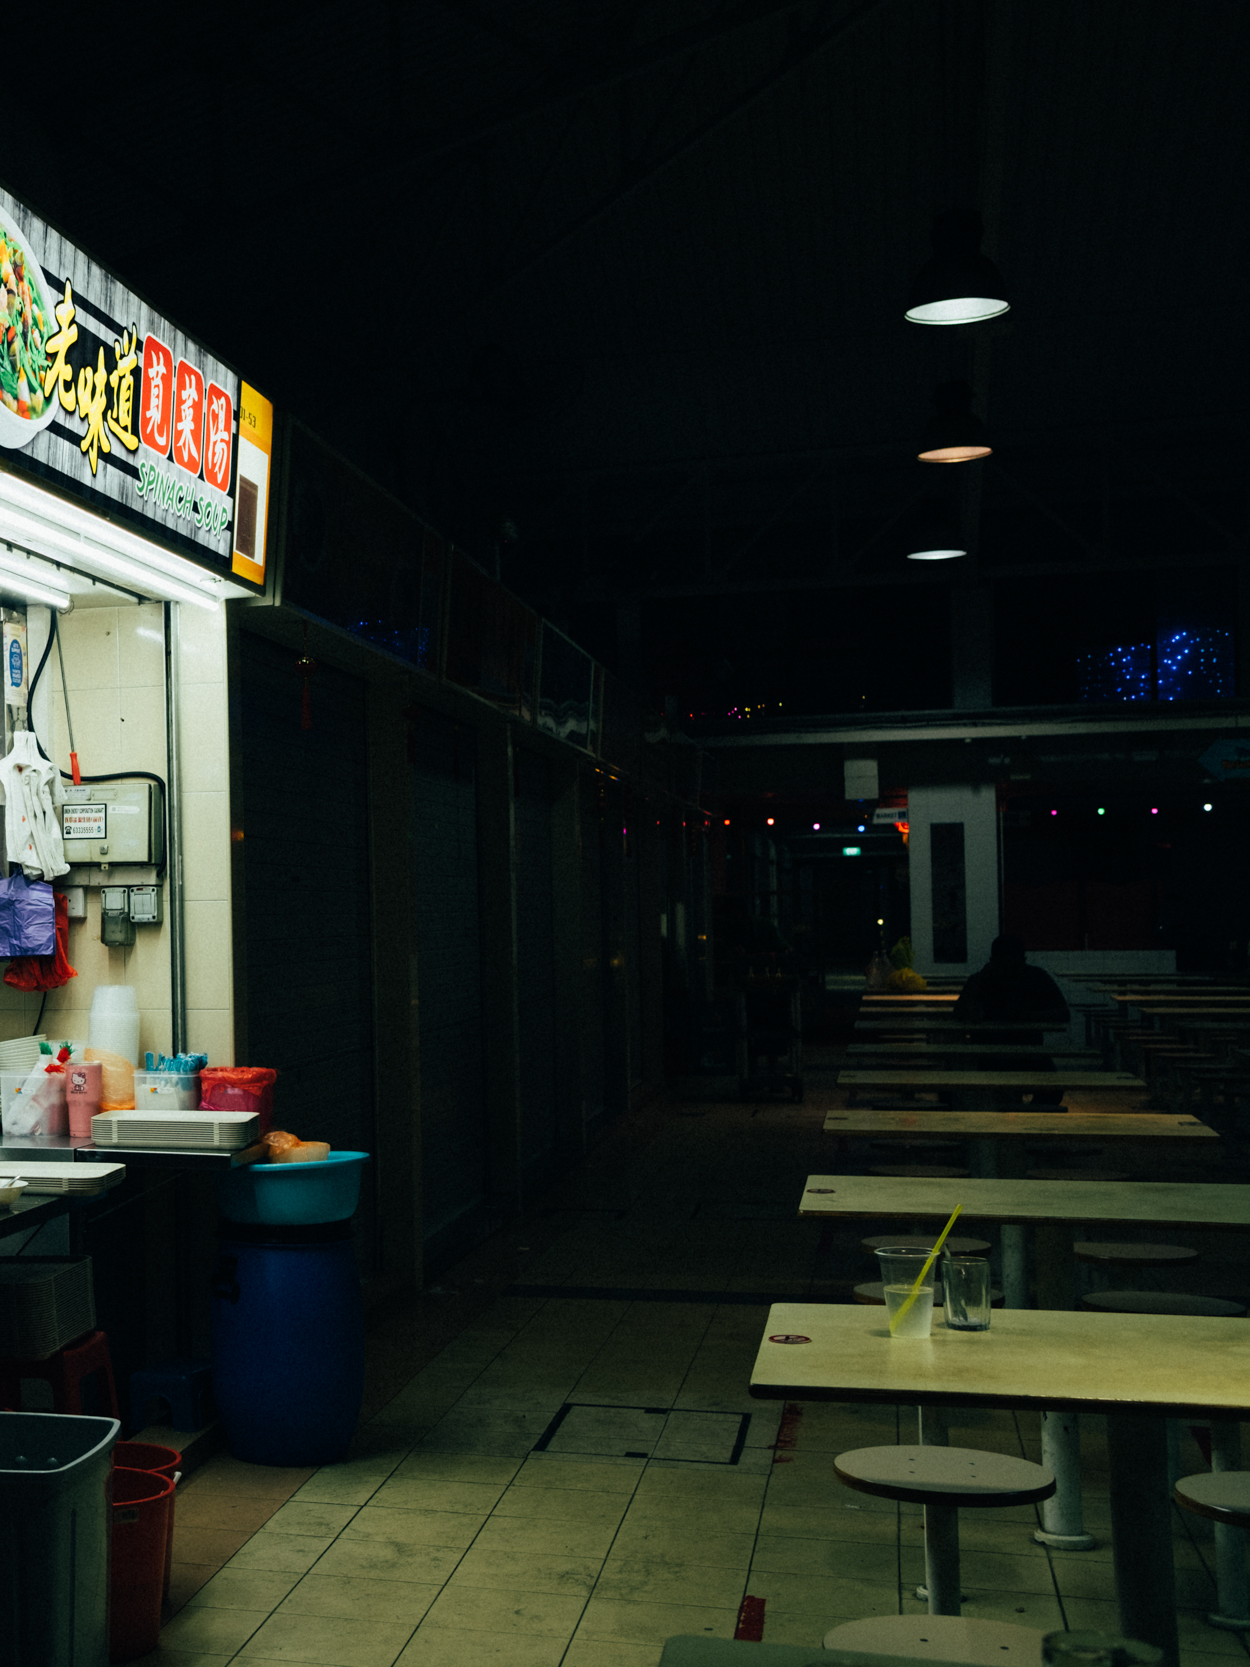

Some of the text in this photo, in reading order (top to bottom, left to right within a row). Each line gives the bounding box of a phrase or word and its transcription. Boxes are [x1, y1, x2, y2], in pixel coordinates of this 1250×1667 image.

[44, 278, 139, 476] 老味道
[239, 405, 257, 429] 01-53
[136, 460, 228, 539] SPINACH SOUP
